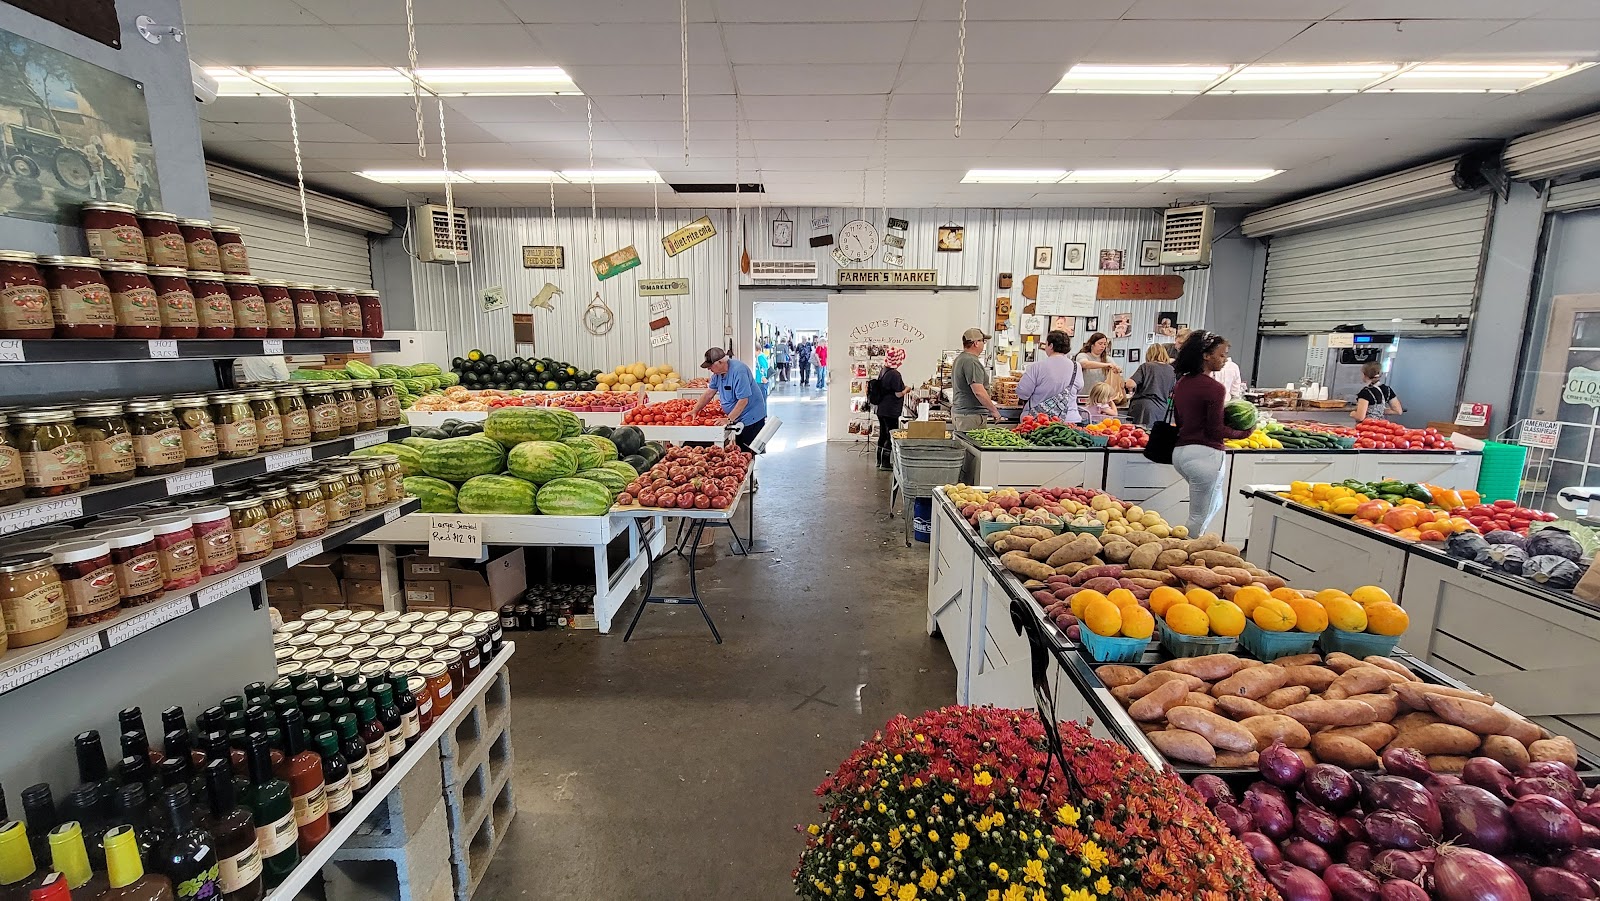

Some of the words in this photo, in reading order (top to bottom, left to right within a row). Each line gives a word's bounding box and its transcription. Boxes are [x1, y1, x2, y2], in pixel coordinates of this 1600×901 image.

[698, 225, 712, 236] cola
[894, 272, 935, 282] MARKET
[850, 320, 889, 339] Ayers
[894, 318, 925, 340] Farm
[901, 337, 913, 345] for
[1524, 426, 1556, 435] CLASSIFIEDS
[1525, 420, 1557, 429] AMERICAN
[52, 448, 63, 456] THE
[166, 474, 193, 484] SWEET
[194, 470, 212, 479] DILL
[47, 497, 78, 512] SPICY
[40, 508, 82, 523] SPEARS
[432, 517, 454, 533] Large
[433, 532, 450, 541] Red
[199, 580, 229, 597] PICKLED
[26, 592, 38, 601] THE
[31, 616, 49, 625] PEANUT
[109, 612, 150, 635] PICKLED
[160, 595, 190, 612] CURED
[114, 623, 148, 643] POLISH
[150, 605, 190, 627] SAUSAGE
[0, 656, 43, 680] AMISH
[48, 635, 96, 660] PEANUT
[0, 665, 51, 692] BUTTER
[54, 645, 99, 668] SPREAD
